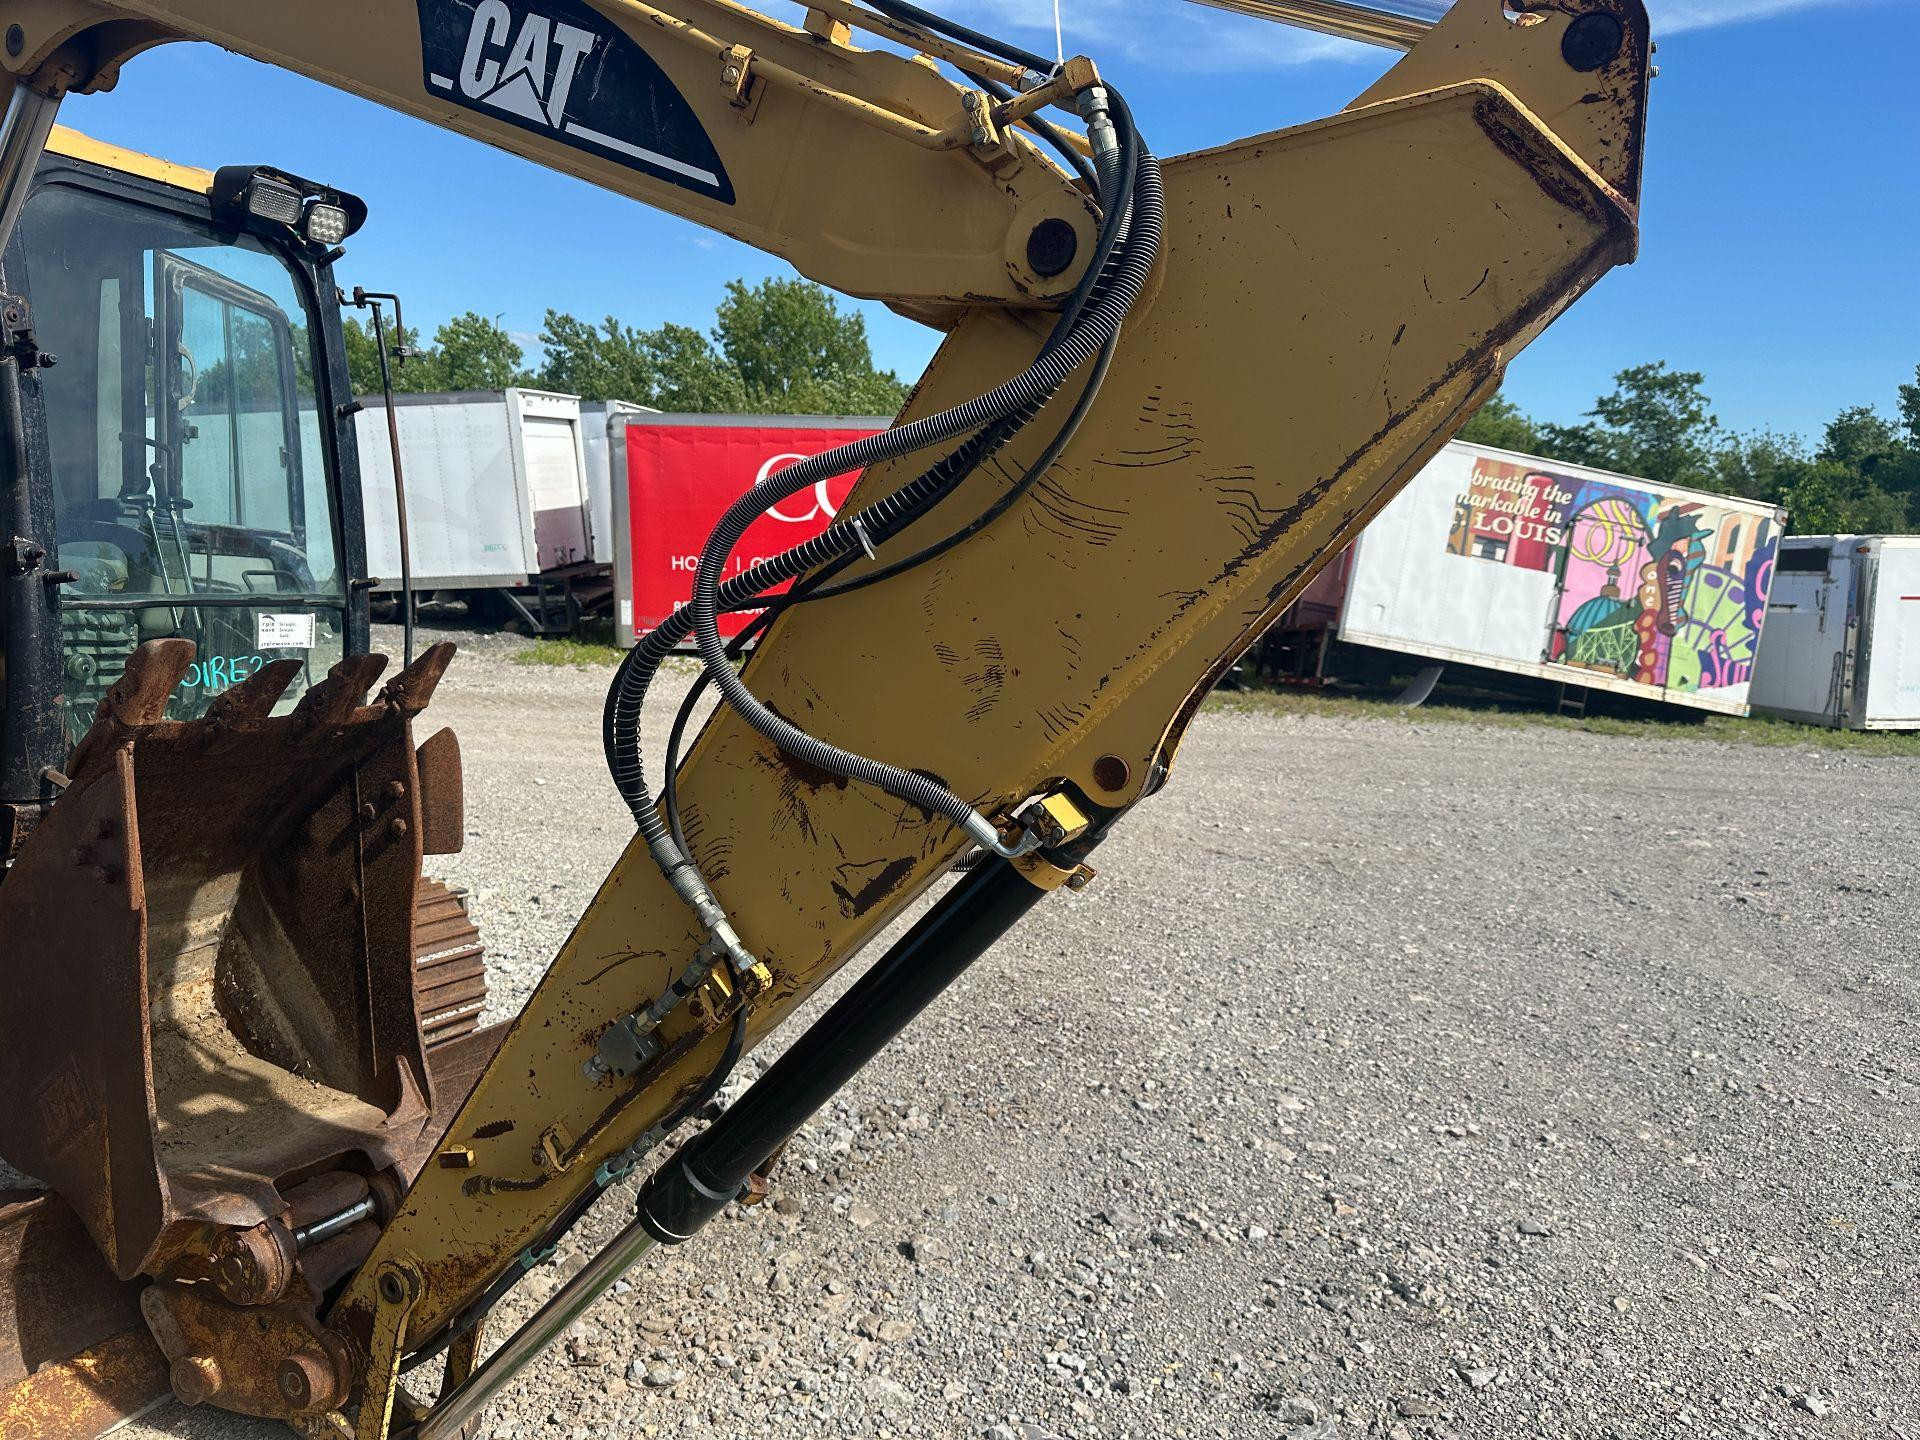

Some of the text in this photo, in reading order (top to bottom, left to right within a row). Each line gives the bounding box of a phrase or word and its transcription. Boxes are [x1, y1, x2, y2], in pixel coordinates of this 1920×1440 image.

[459, 0, 596, 129] CAT
[1472, 468, 1573, 505] brating the
[1474, 512, 1561, 545] LOUIS
[1544, 504, 1562, 524] in
